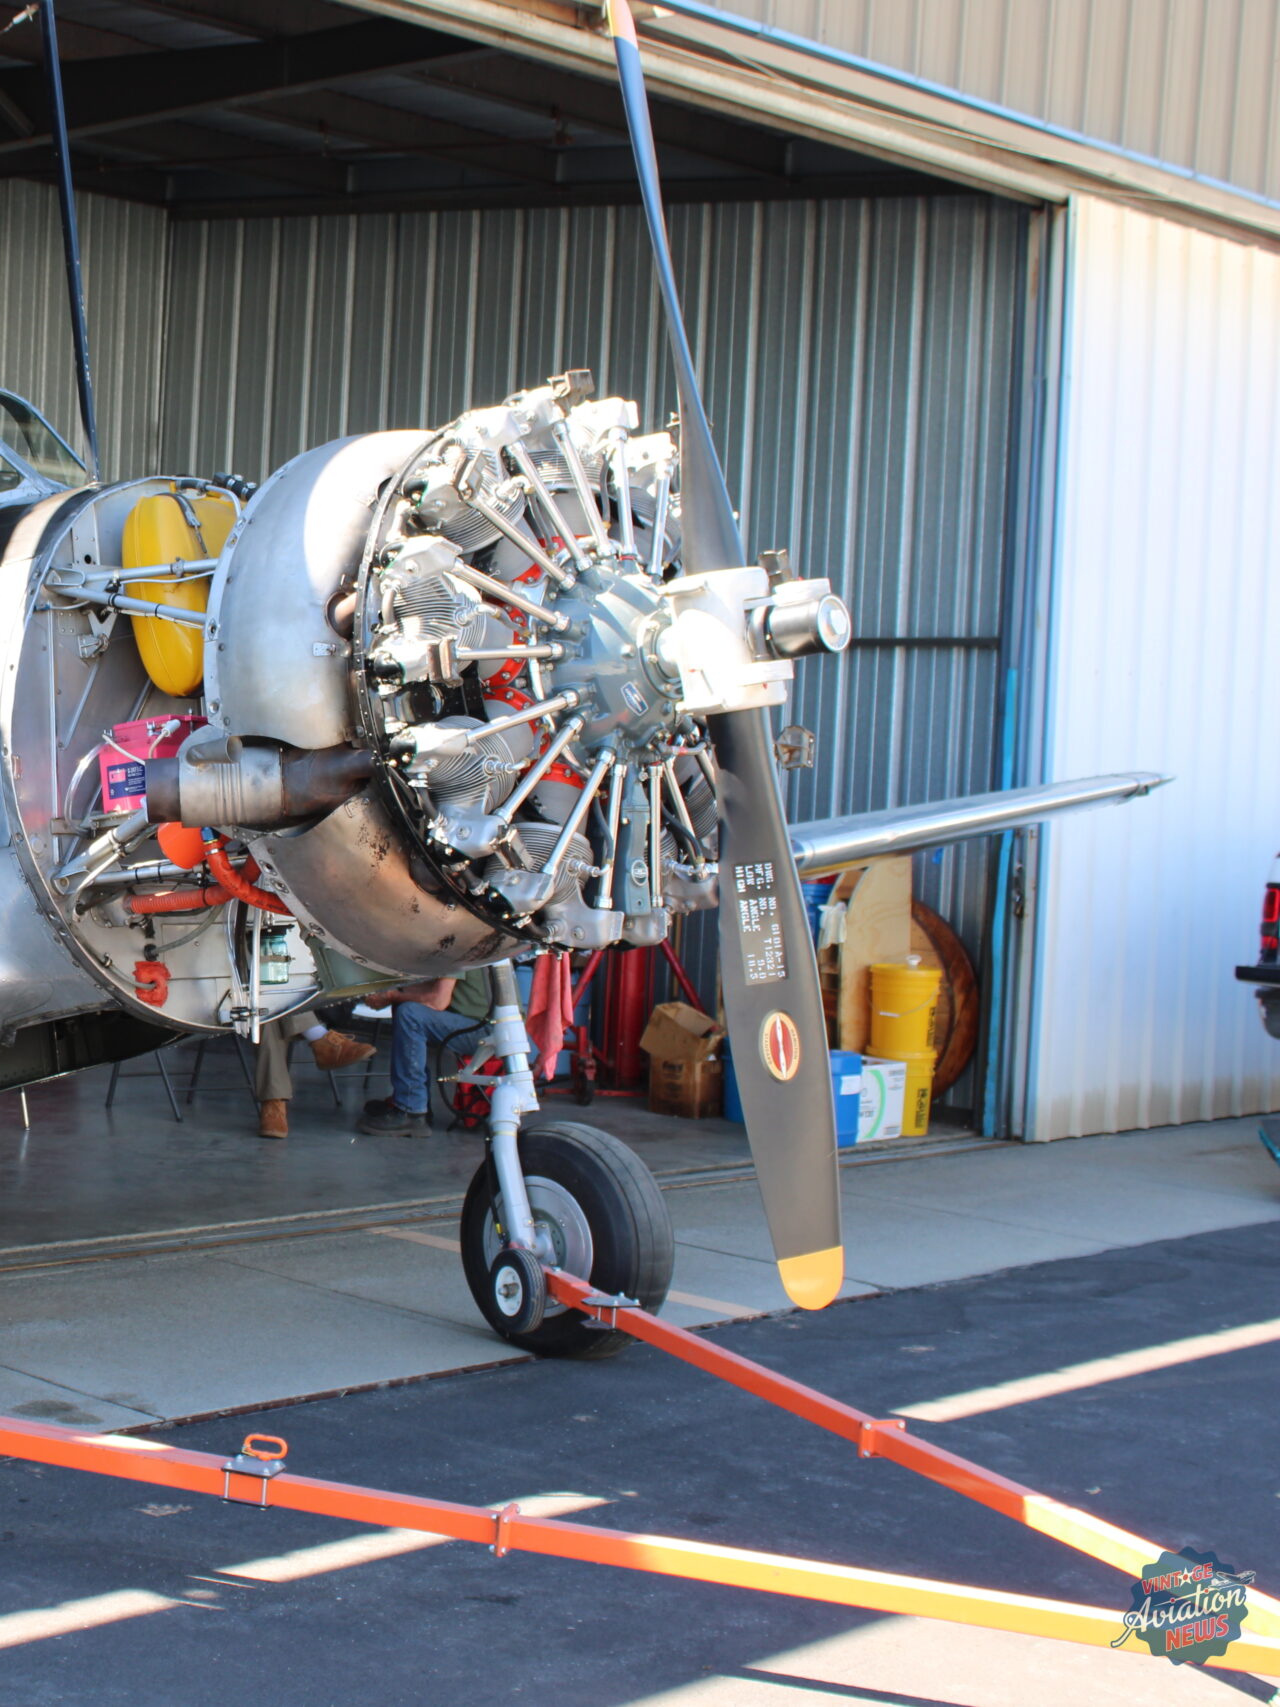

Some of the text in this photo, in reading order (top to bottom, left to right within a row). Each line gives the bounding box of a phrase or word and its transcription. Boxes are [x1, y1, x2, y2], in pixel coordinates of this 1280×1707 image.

[735, 866, 746, 893] HIGH
[745, 865, 755, 885] LOW
[755, 864, 765, 890] MFG.
[764, 863, 774, 889] DWG.
[740, 900, 752, 932] ANGLE
[749, 899, 761, 932] ANGLE
[759, 897, 768, 916] NO.
[768, 897, 777, 916] NO.
